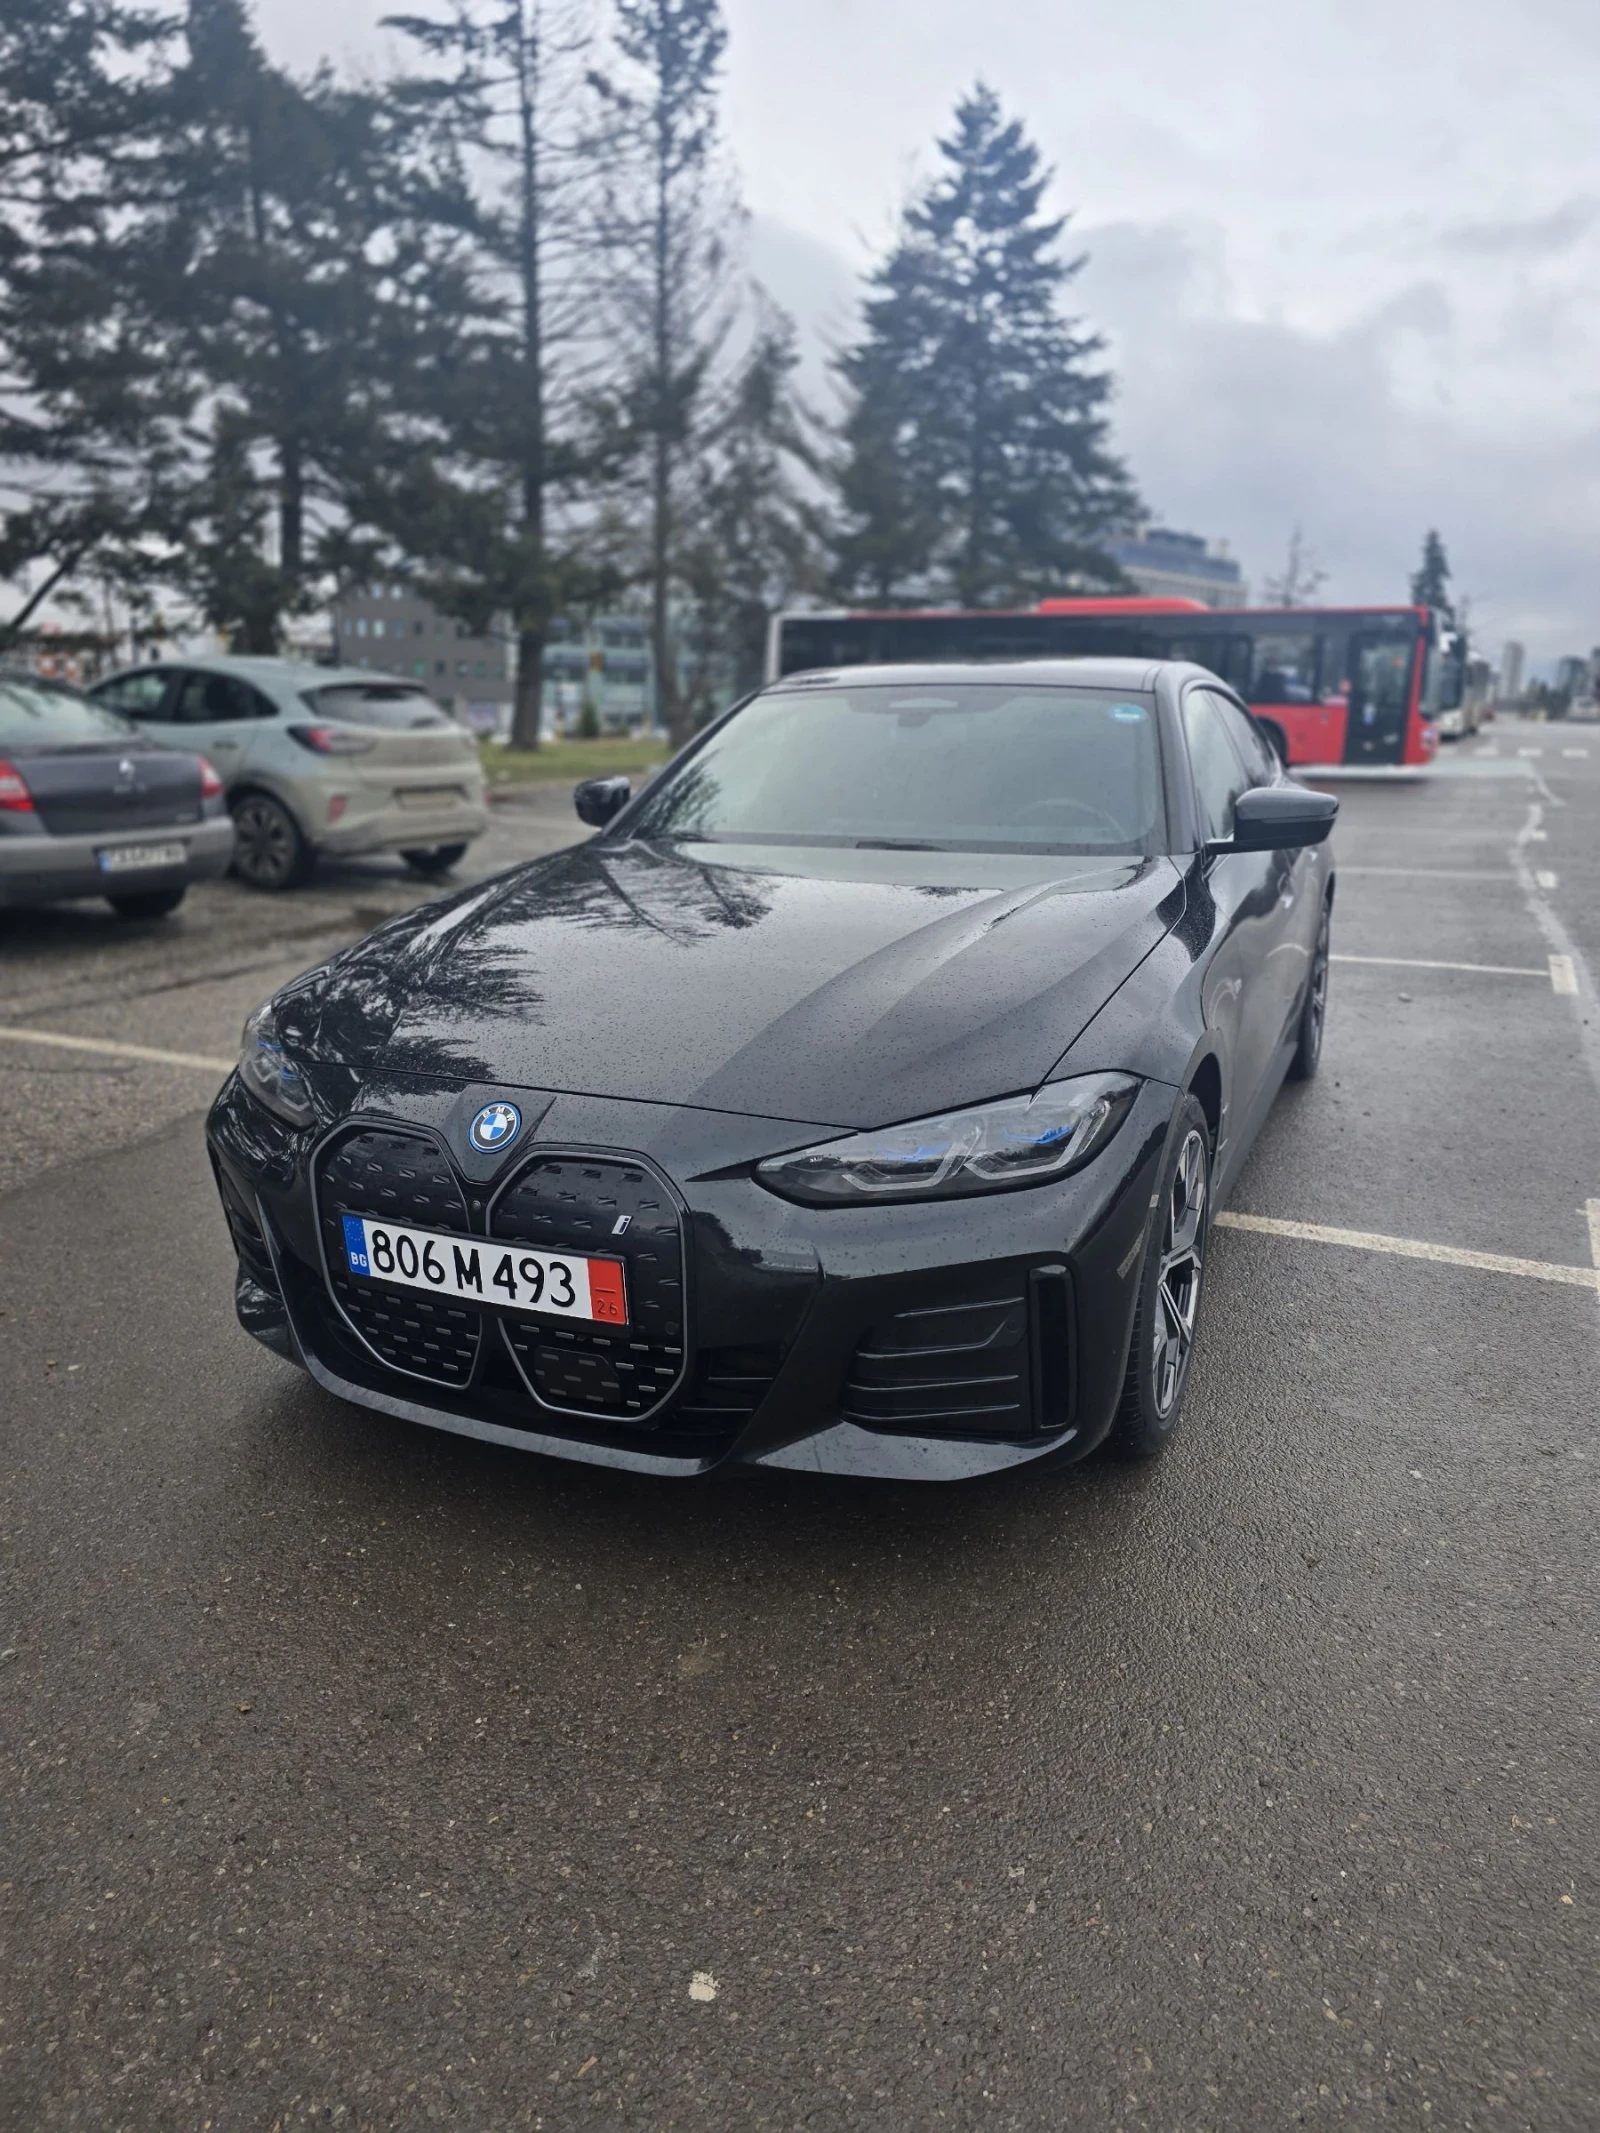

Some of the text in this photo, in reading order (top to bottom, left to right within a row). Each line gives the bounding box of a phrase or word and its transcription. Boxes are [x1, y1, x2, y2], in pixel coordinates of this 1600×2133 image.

[482, 1106, 515, 1121] BMW
[350, 1252, 368, 1267] BG
[372, 1229, 576, 1308] 806 M 493
[598, 1300, 618, 1316] 26
